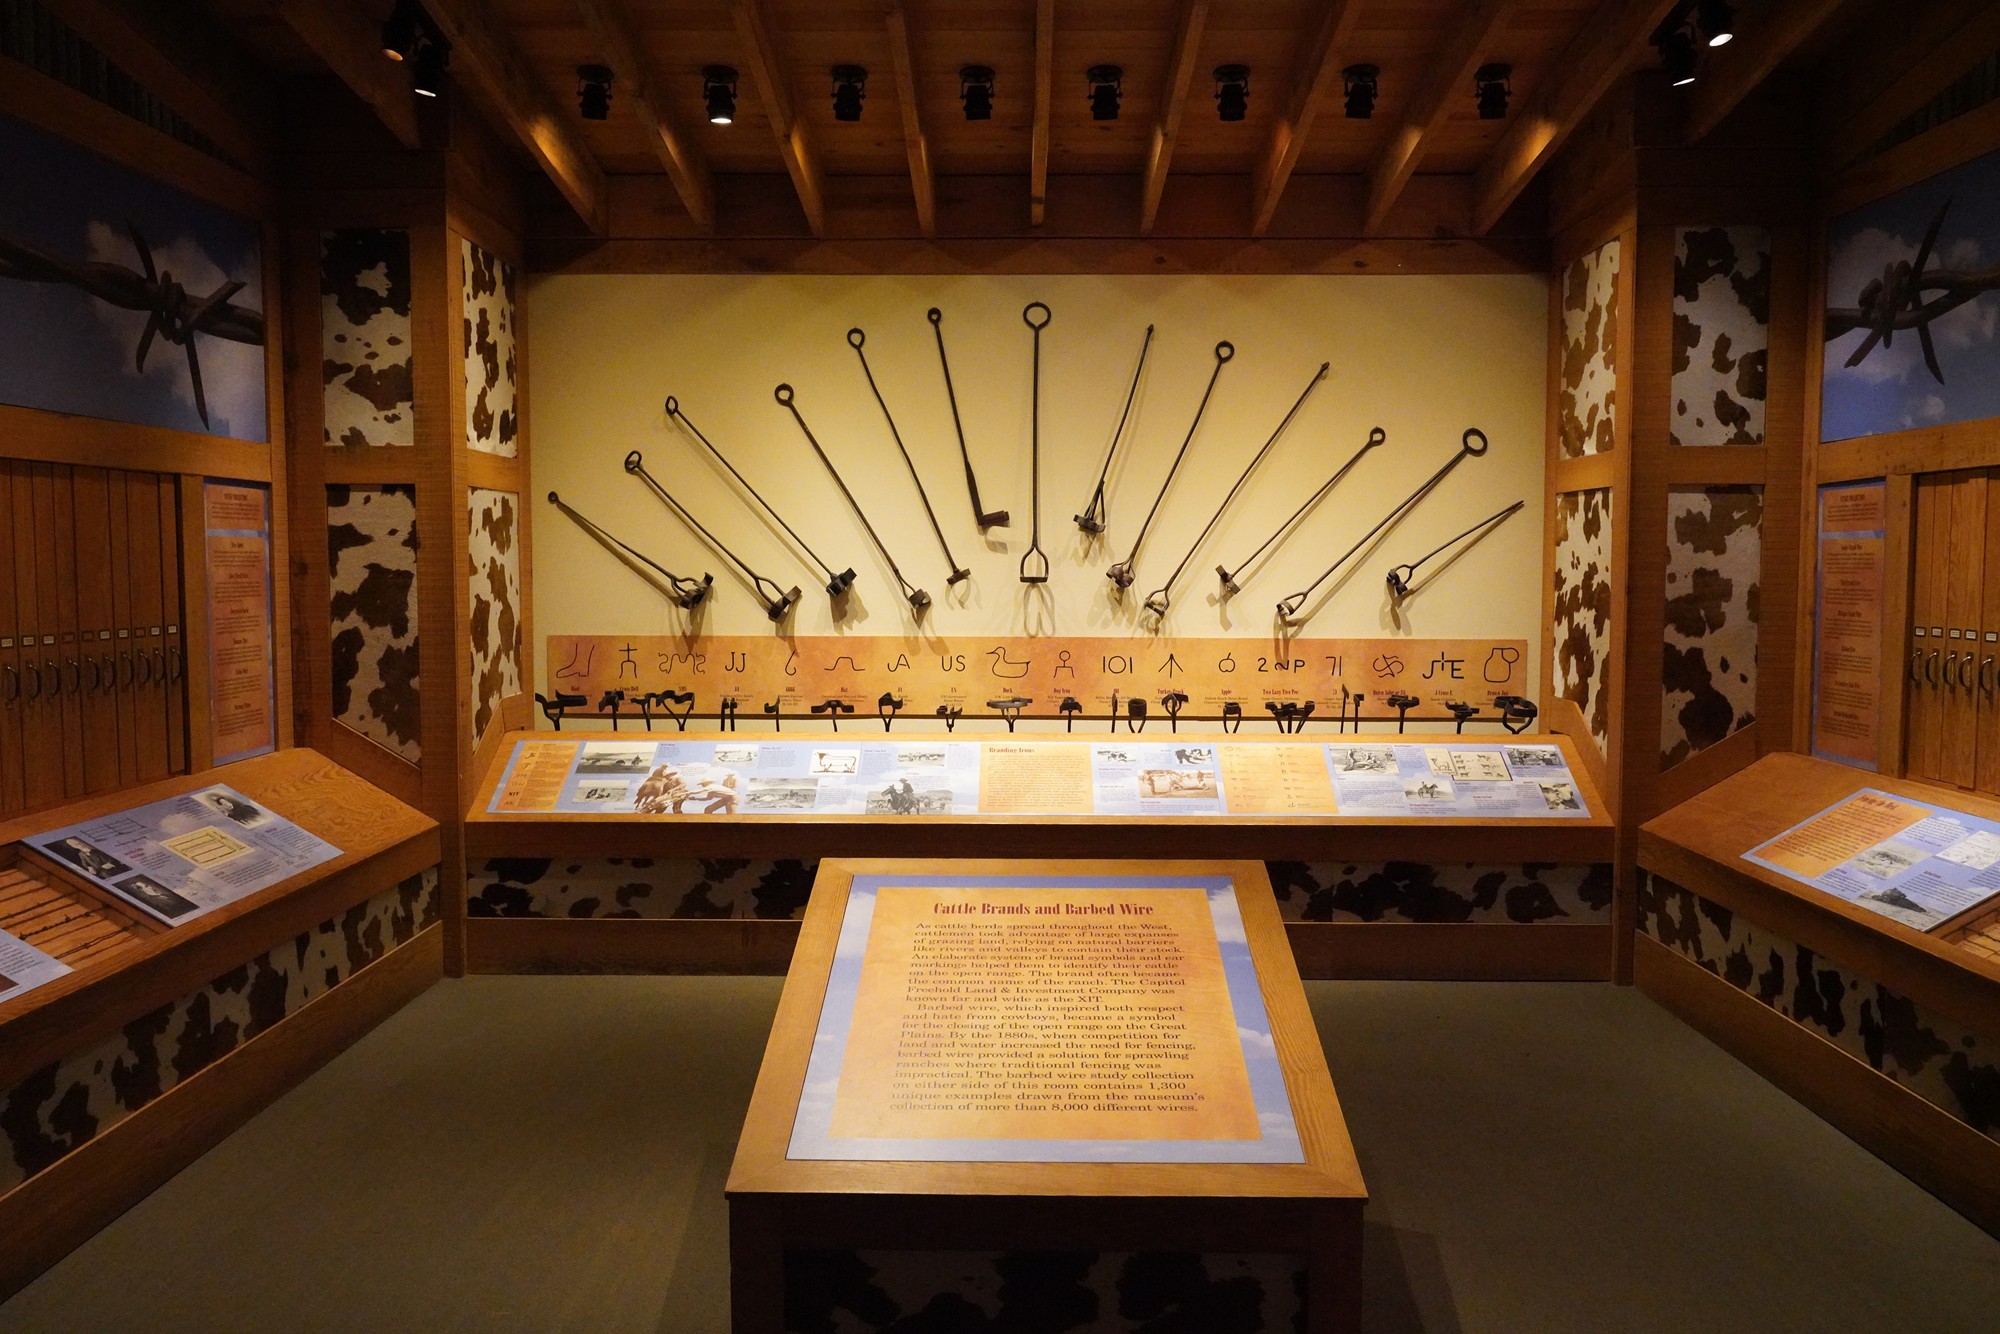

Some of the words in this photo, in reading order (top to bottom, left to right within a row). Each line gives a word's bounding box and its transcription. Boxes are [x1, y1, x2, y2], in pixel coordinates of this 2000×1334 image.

[941, 654, 966, 672] US
[934, 903, 976, 915] Cattle
[982, 903, 1030, 915] Brands
[1035, 903, 1060, 915] and
[1066, 904, 1115, 916] Barbed
[1120, 904, 1153, 916] Wire
[1006, 923, 1045, 931] spread
[1049, 923, 1112, 931] throughout
[1008, 930, 1071, 939] advantage
[1090, 930, 1120, 939] large
[928, 938, 974, 947] grazing
[1012, 938, 1055, 947] relying
[990, 953, 1032, 962] system
[1088, 954, 1136, 963] symbols
[911, 961, 967, 970] markings
[971, 961, 1010, 970] helped
[1064, 962, 1108, 971] identify
[1139, 978, 1185, 988] Capitol
[1089, 986, 1146, 996] Company
[918, 1003, 963, 1011] Barbed
[1004, 1003, 1042, 1011] which
[1048, 1003, 1100, 1014] inspired
[1104, 1003, 1133, 1011] both
[1138, 1004, 1184, 1014] respect
[902, 1021, 919, 1029] for
[923, 1021, 943, 1029] the
[947, 1021, 990, 1032] closing
[993, 1021, 1006, 1030] of
[1009, 1022, 1029, 1030] the
[1032, 1024, 1062, 1032] open
[1067, 1024, 1103, 1032] range
[1126, 1022, 1146, 1030] the
[1150, 1022, 1186, 1030] Great
[950, 1031, 966, 1041] By
[1042, 1031, 1076, 1039] when
[1081, 1031, 1158, 1041] competition
[1163, 1031, 1181, 1039] for
[900, 1040, 926, 1048] land
[932, 1040, 955, 1048] and
[960, 1040, 994, 1049] water
[1001, 1040, 1061, 1049] increased
[1066, 1040, 1086, 1049] the
[1090, 1041, 1120, 1049] need
[1124, 1041, 1142, 1049] for
[898, 1050, 941, 1058] barbed
[946, 1050, 974, 1058] wire
[978, 1050, 1033, 1061] provided
[1048, 1050, 1099, 1058] solution
[1104, 1050, 1122, 1058] for
[1125, 1051, 1189, 1061] sprawling
[914, 1080, 956, 1088] either
[961, 1080, 989, 1089] side
[994, 1080, 1008, 1089] of
[1012, 1080, 1038, 1089] this
[1084, 1081, 1143, 1089] contains
[1150, 1081, 1186, 1092] 1,300
[890, 1101, 953, 1110] collection
[958, 1101, 972, 1110] of
[1015, 1102, 1046, 1110] than
[1052, 1102, 1089, 1113] 8,000
[1093, 1102, 1151, 1111] different
